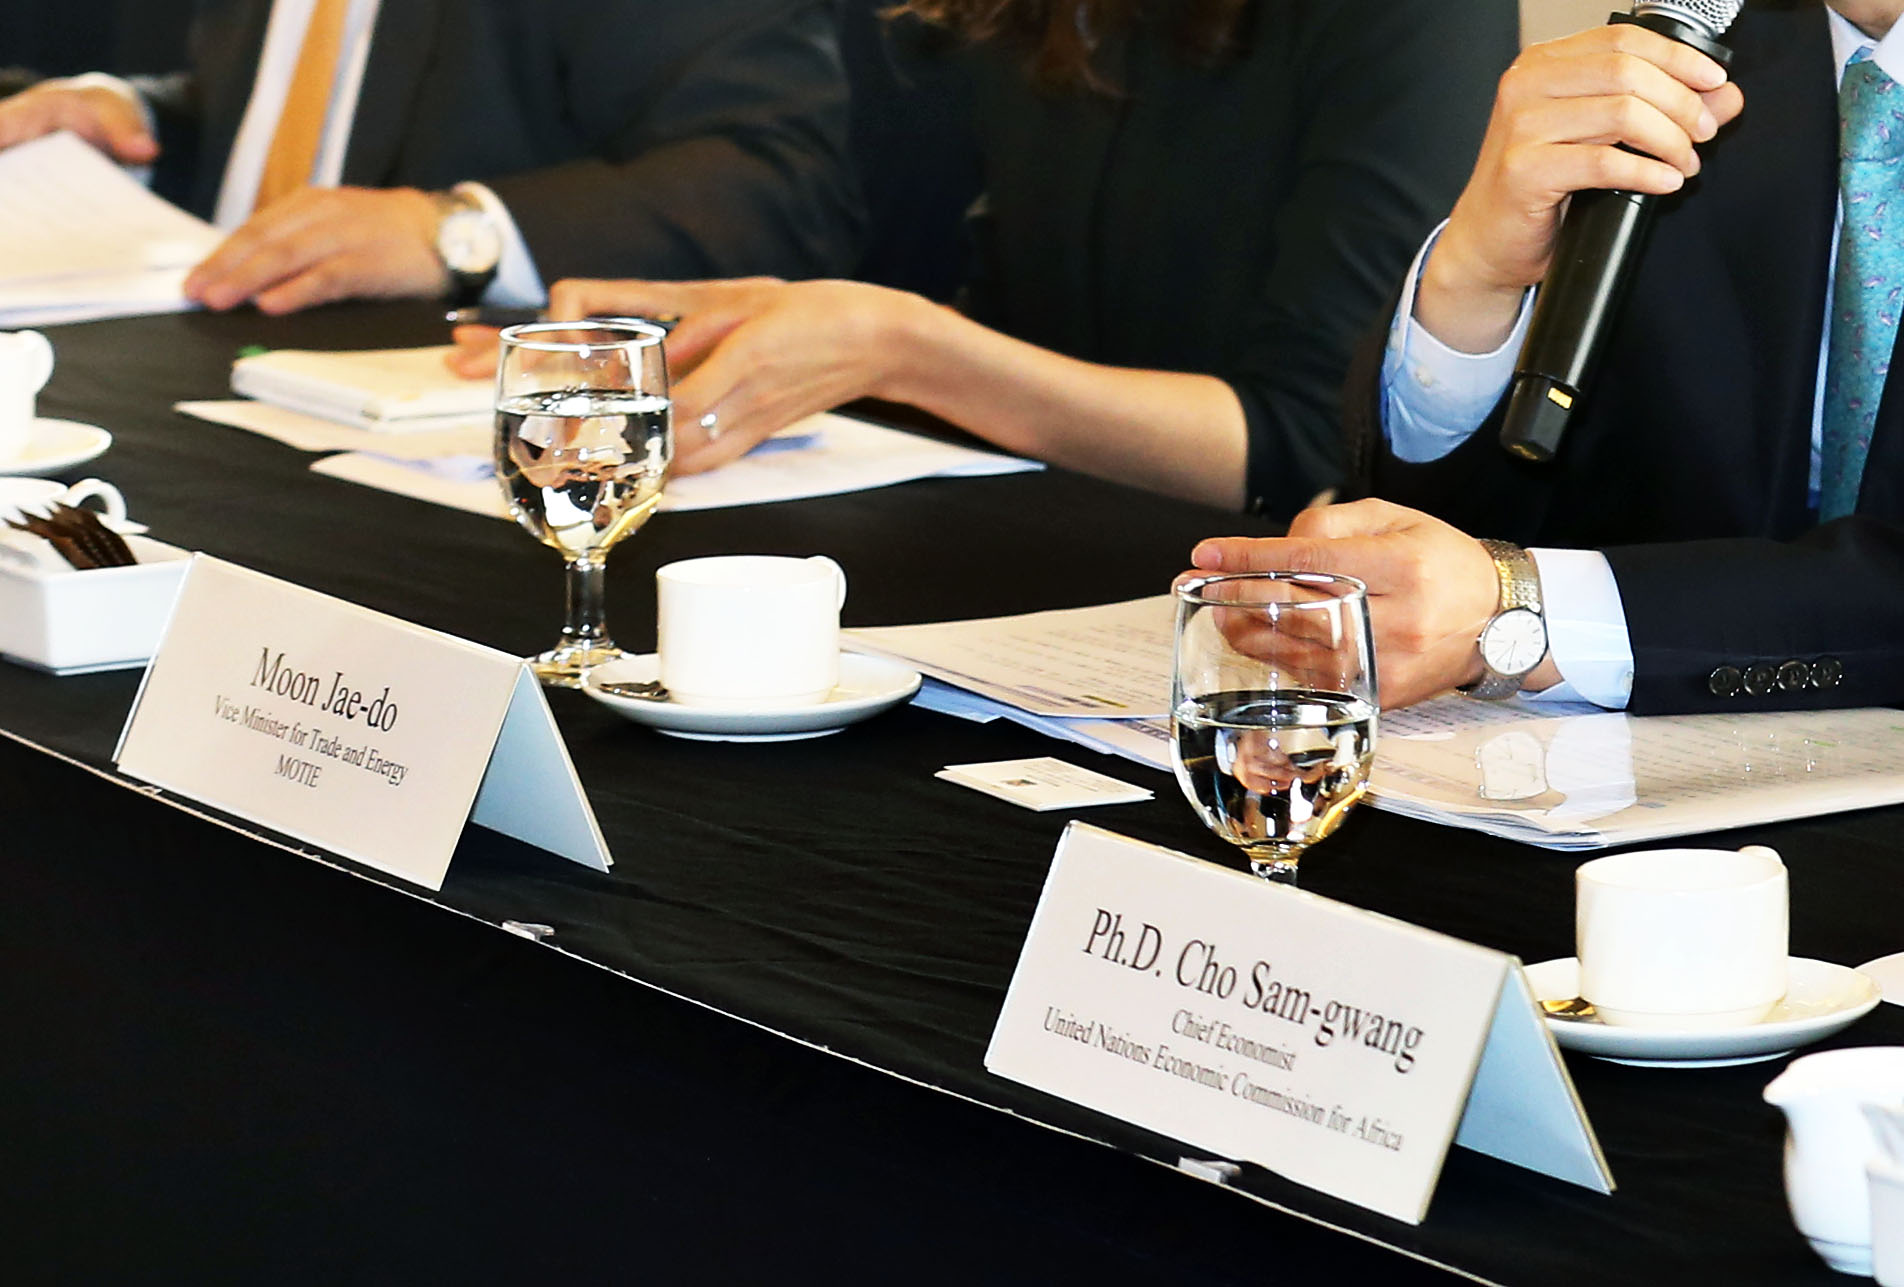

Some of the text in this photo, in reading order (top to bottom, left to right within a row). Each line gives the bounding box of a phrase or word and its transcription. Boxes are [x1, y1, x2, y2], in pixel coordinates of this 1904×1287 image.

[251, 647, 397, 732] Moon Jae-do
[216, 695, 408, 786] Vice Minister for Trade and Energy
[275, 754, 322, 787] MOTIE
[1083, 909, 1423, 1073] Ph.D. Cho Sam-gwang
[1044, 1007, 1402, 1151] United Nations Economic Commission for Africa
[1172, 1010, 1296, 1071] Chief Economist
